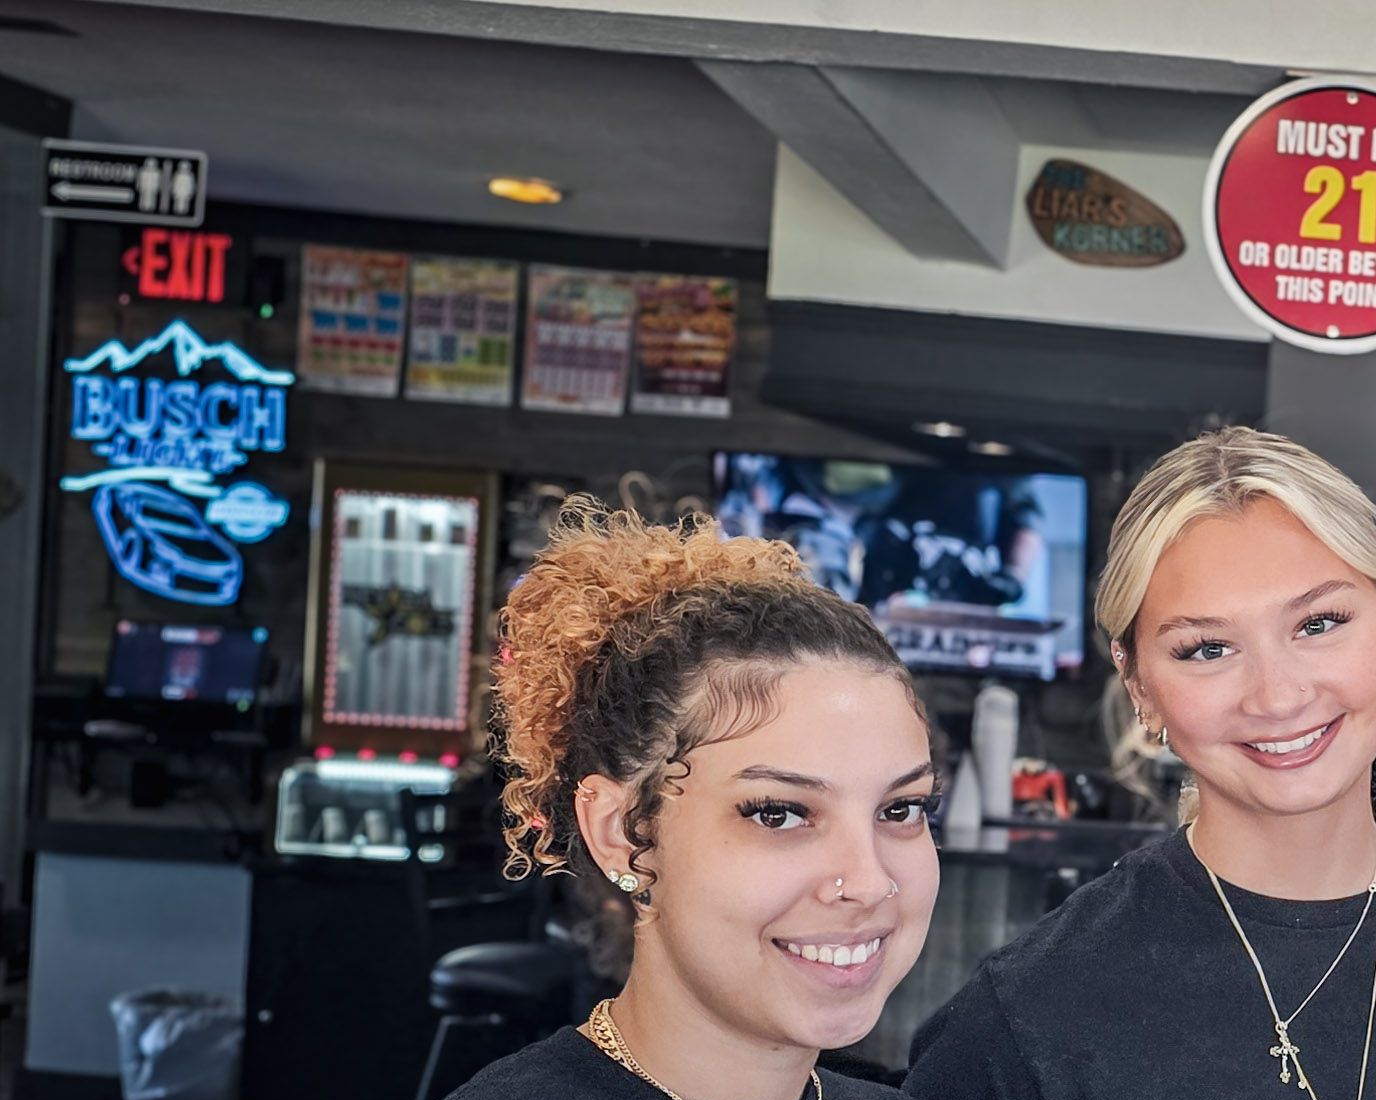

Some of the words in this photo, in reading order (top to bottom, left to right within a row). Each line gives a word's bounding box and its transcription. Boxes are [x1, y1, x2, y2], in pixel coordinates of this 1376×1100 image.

[1277, 119, 1364, 160] MUST
[1053, 222, 1169, 255] KORNER
[1239, 240, 1270, 267] OR
[1274, 244, 1343, 274] OLDER
[138, 227, 233, 303] EXIT
[1276, 275, 1324, 303] THIS
[71, 373, 288, 451] BUSCH
[108, 432, 236, 473] LIGHT
